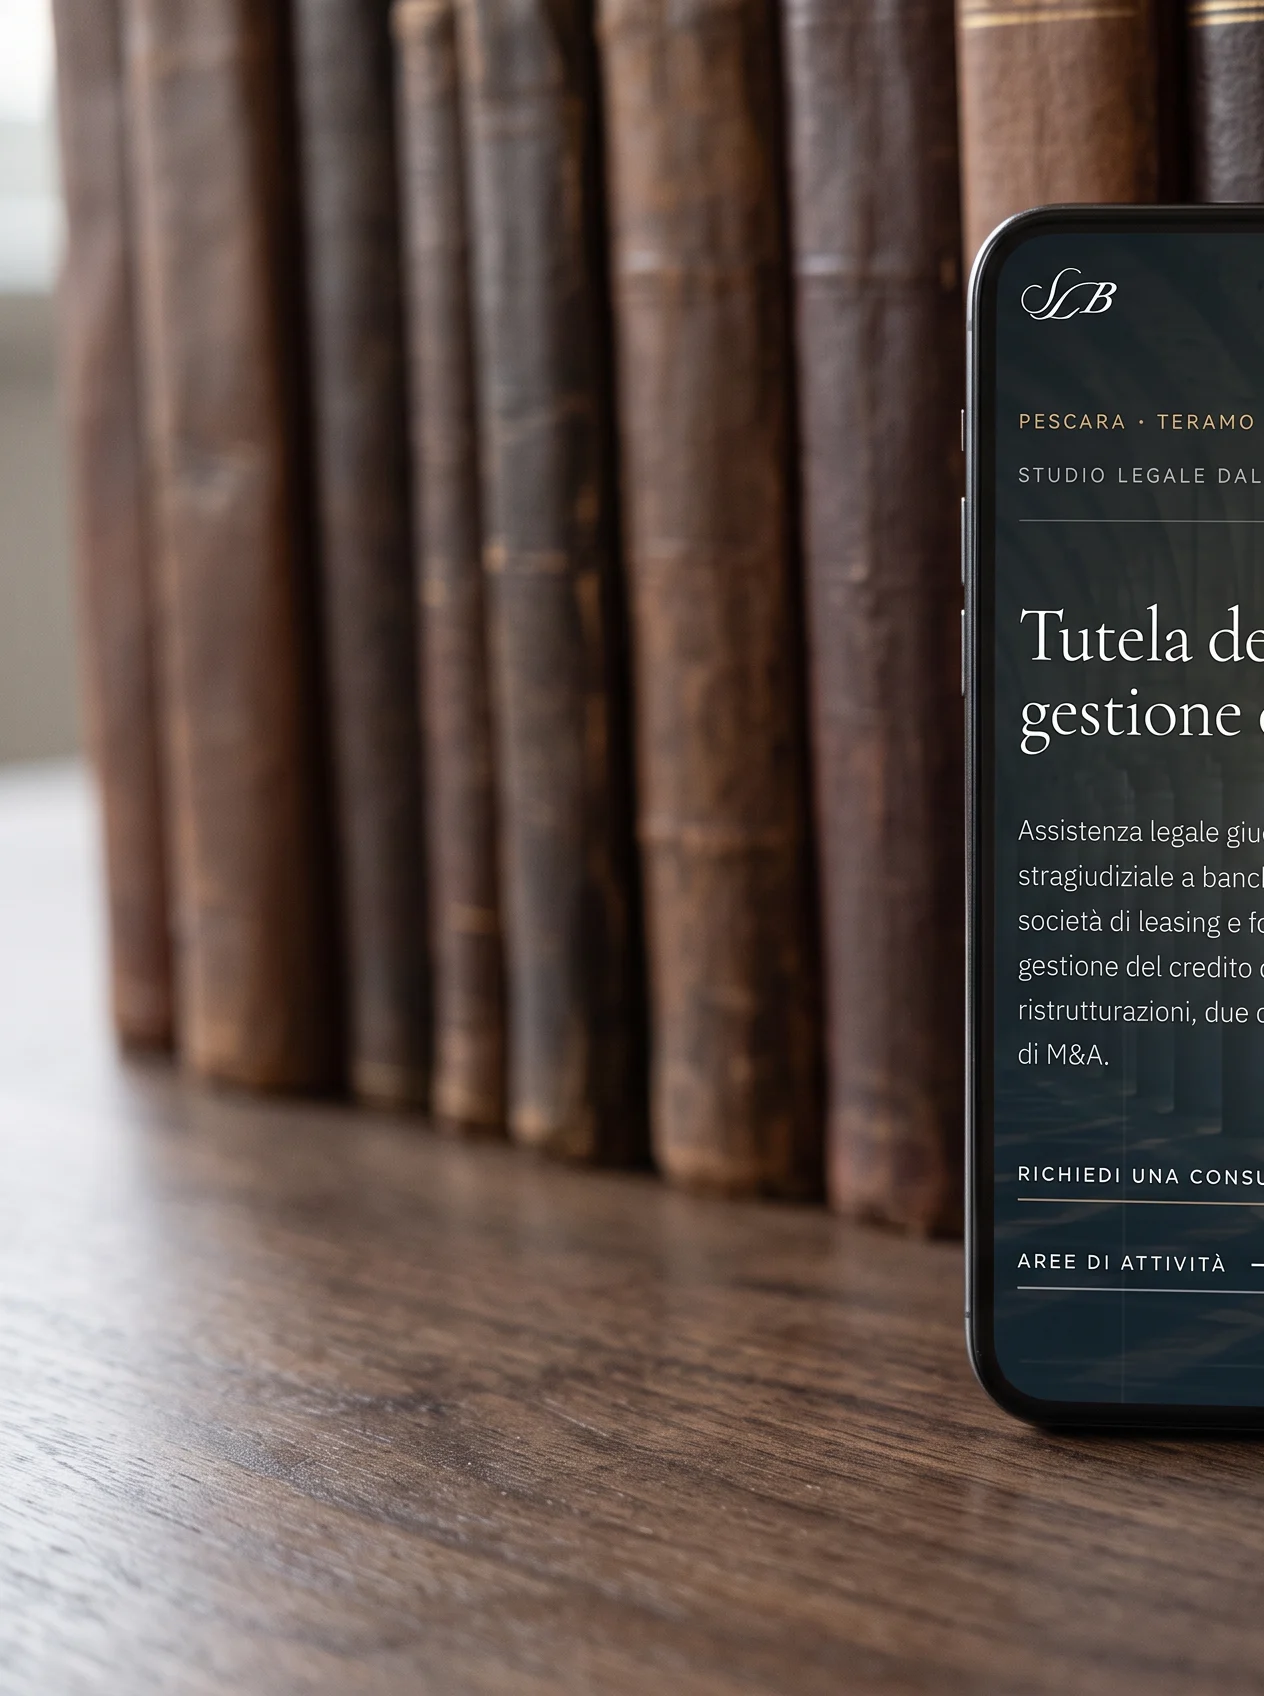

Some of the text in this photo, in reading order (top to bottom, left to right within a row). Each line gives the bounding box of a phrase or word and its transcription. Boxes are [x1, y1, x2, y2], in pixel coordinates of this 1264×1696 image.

[1019, 413, 1125, 430] PESCARA
[1156, 413, 1254, 430] TERAMO
[1018, 466, 1105, 484] STUDIO
[1118, 467, 1205, 484] LEGALE
[1218, 467, 1262, 484] DAL
[1019, 603, 1194, 663] Tutela
[1020, 687, 1241, 756] gestione
[1017, 818, 1144, 842] Assistenza
[1150, 819, 1219, 849] legale
[1018, 864, 1174, 892] stragiudiziale
[1181, 871, 1196, 888] a
[1018, 908, 1103, 932] società
[1110, 909, 1130, 932] di
[1139, 909, 1221, 939] leasing
[1227, 916, 1242, 934] e
[1018, 953, 1119, 982] gestione
[1126, 954, 1163, 978] del
[1169, 955, 1253, 979] credito
[1019, 997, 1197, 1027] ristrutturazioni,
[1204, 999, 1249, 1024] due
[1018, 1041, 1109, 1066] di M&A.
[1018, 1165, 1120, 1183] RICHIEDI
[1132, 1168, 1179, 1185] UNA
[1017, 1252, 1226, 1273] AREE DI ATTIVITÀ
